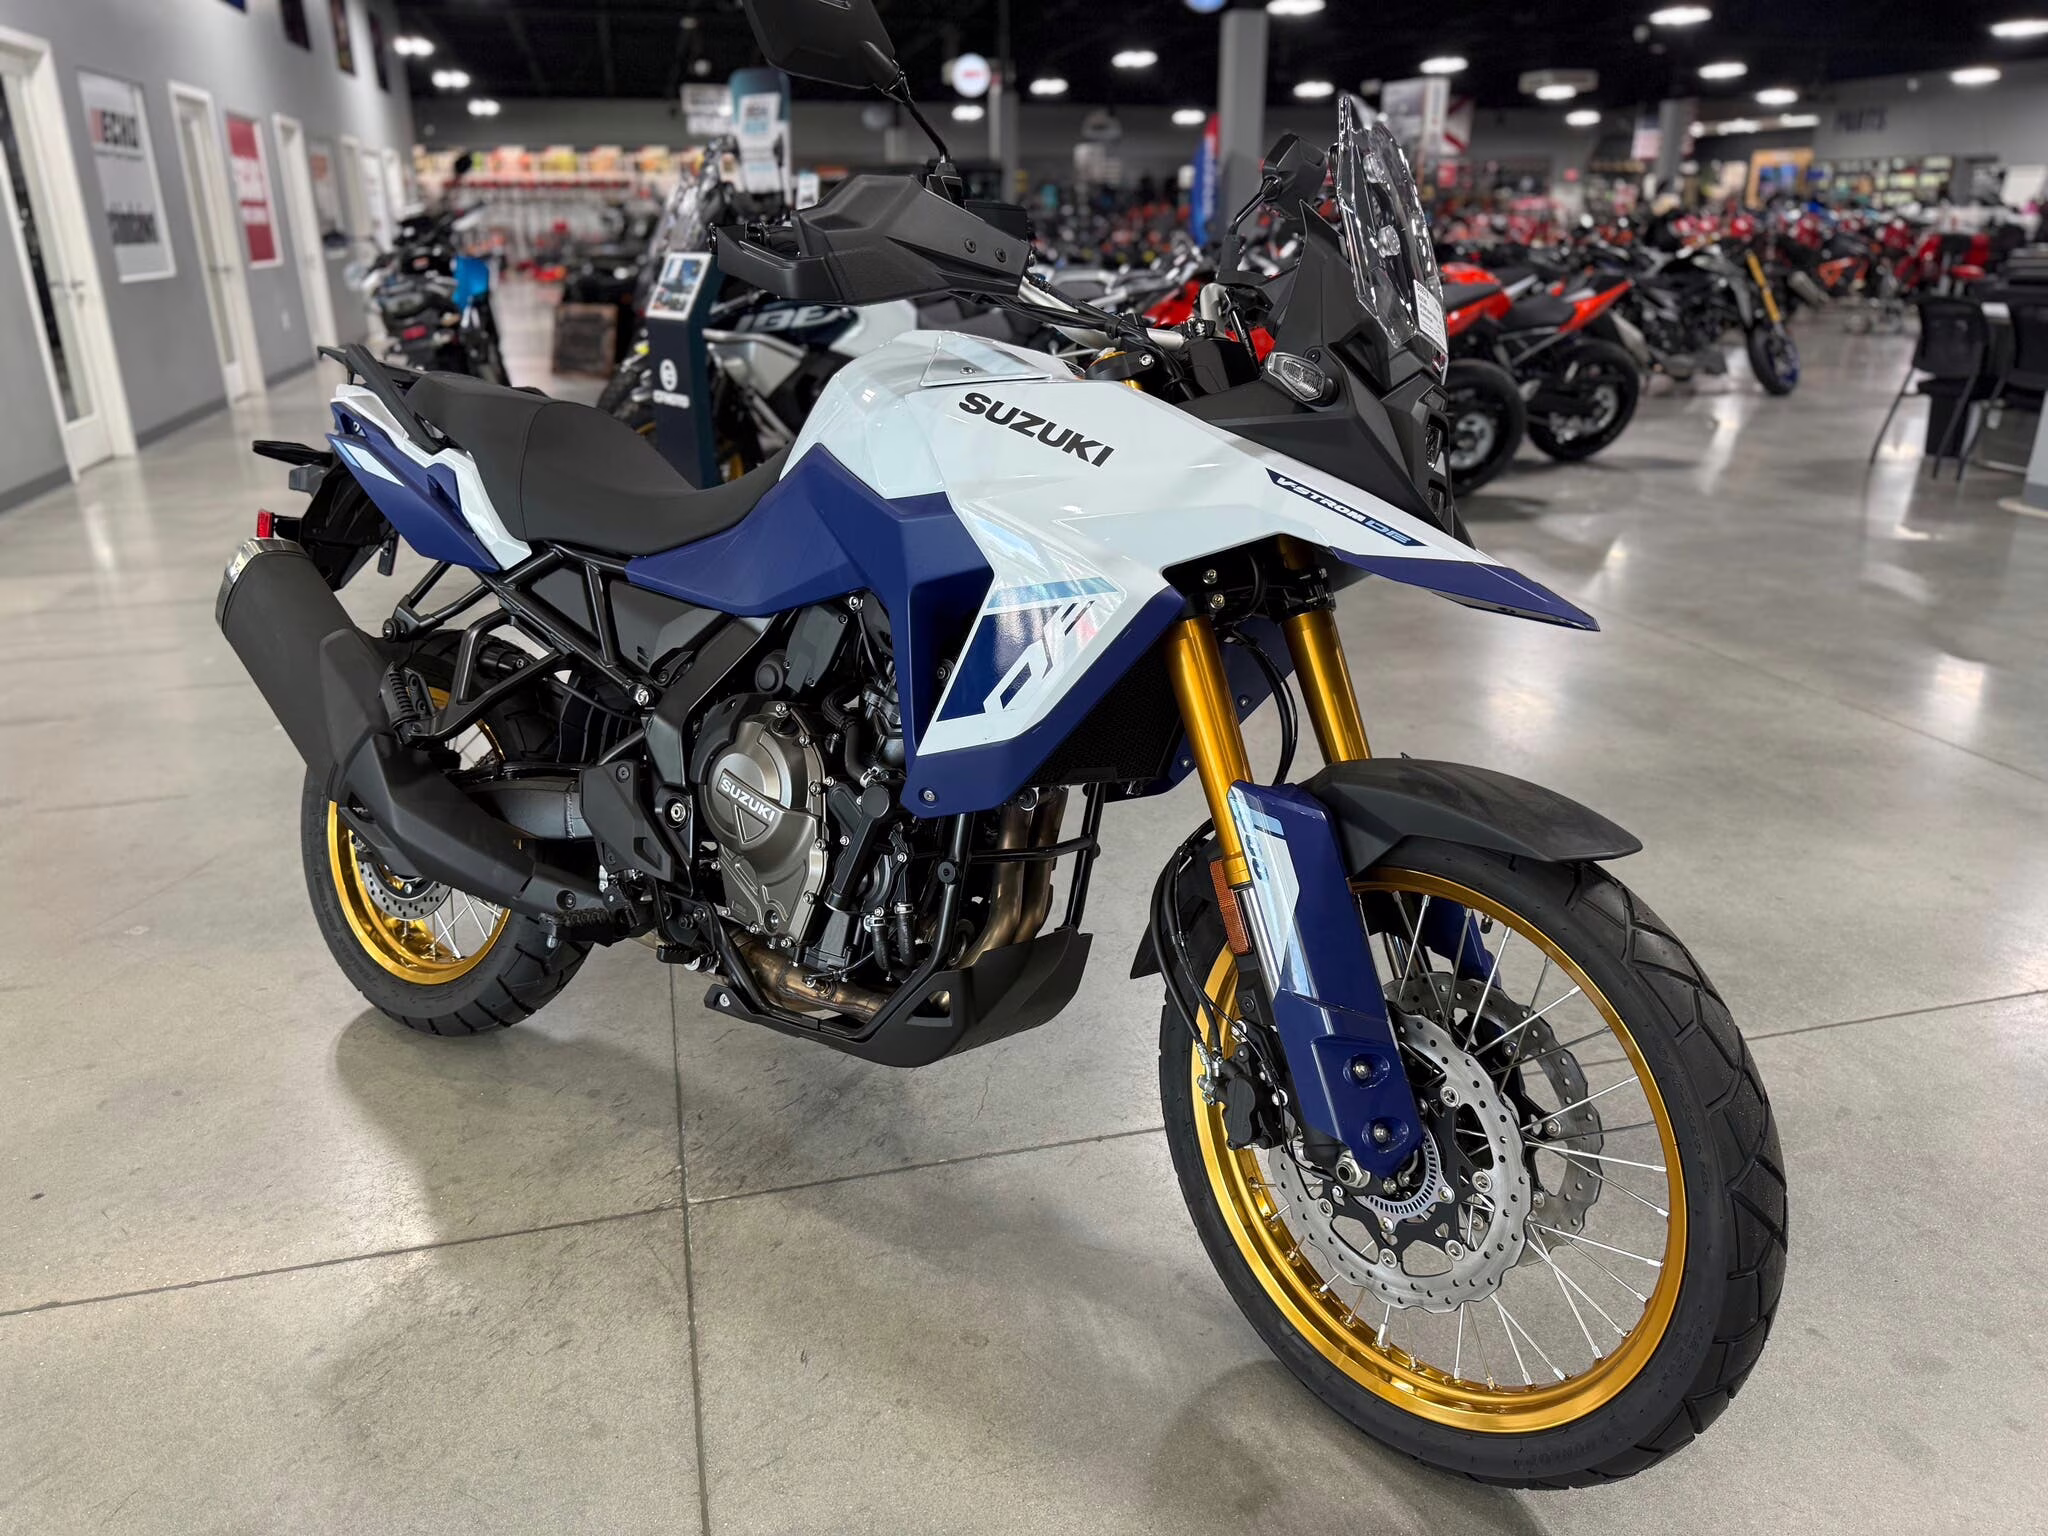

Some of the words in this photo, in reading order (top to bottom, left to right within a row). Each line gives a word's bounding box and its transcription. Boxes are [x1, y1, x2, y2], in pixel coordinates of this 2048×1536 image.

[958, 392, 1115, 467] SUZUKI
[1276, 476, 1367, 522] V-STROM
[1364, 519, 1411, 544] DE
[720, 778, 776, 822] SUZUKI
